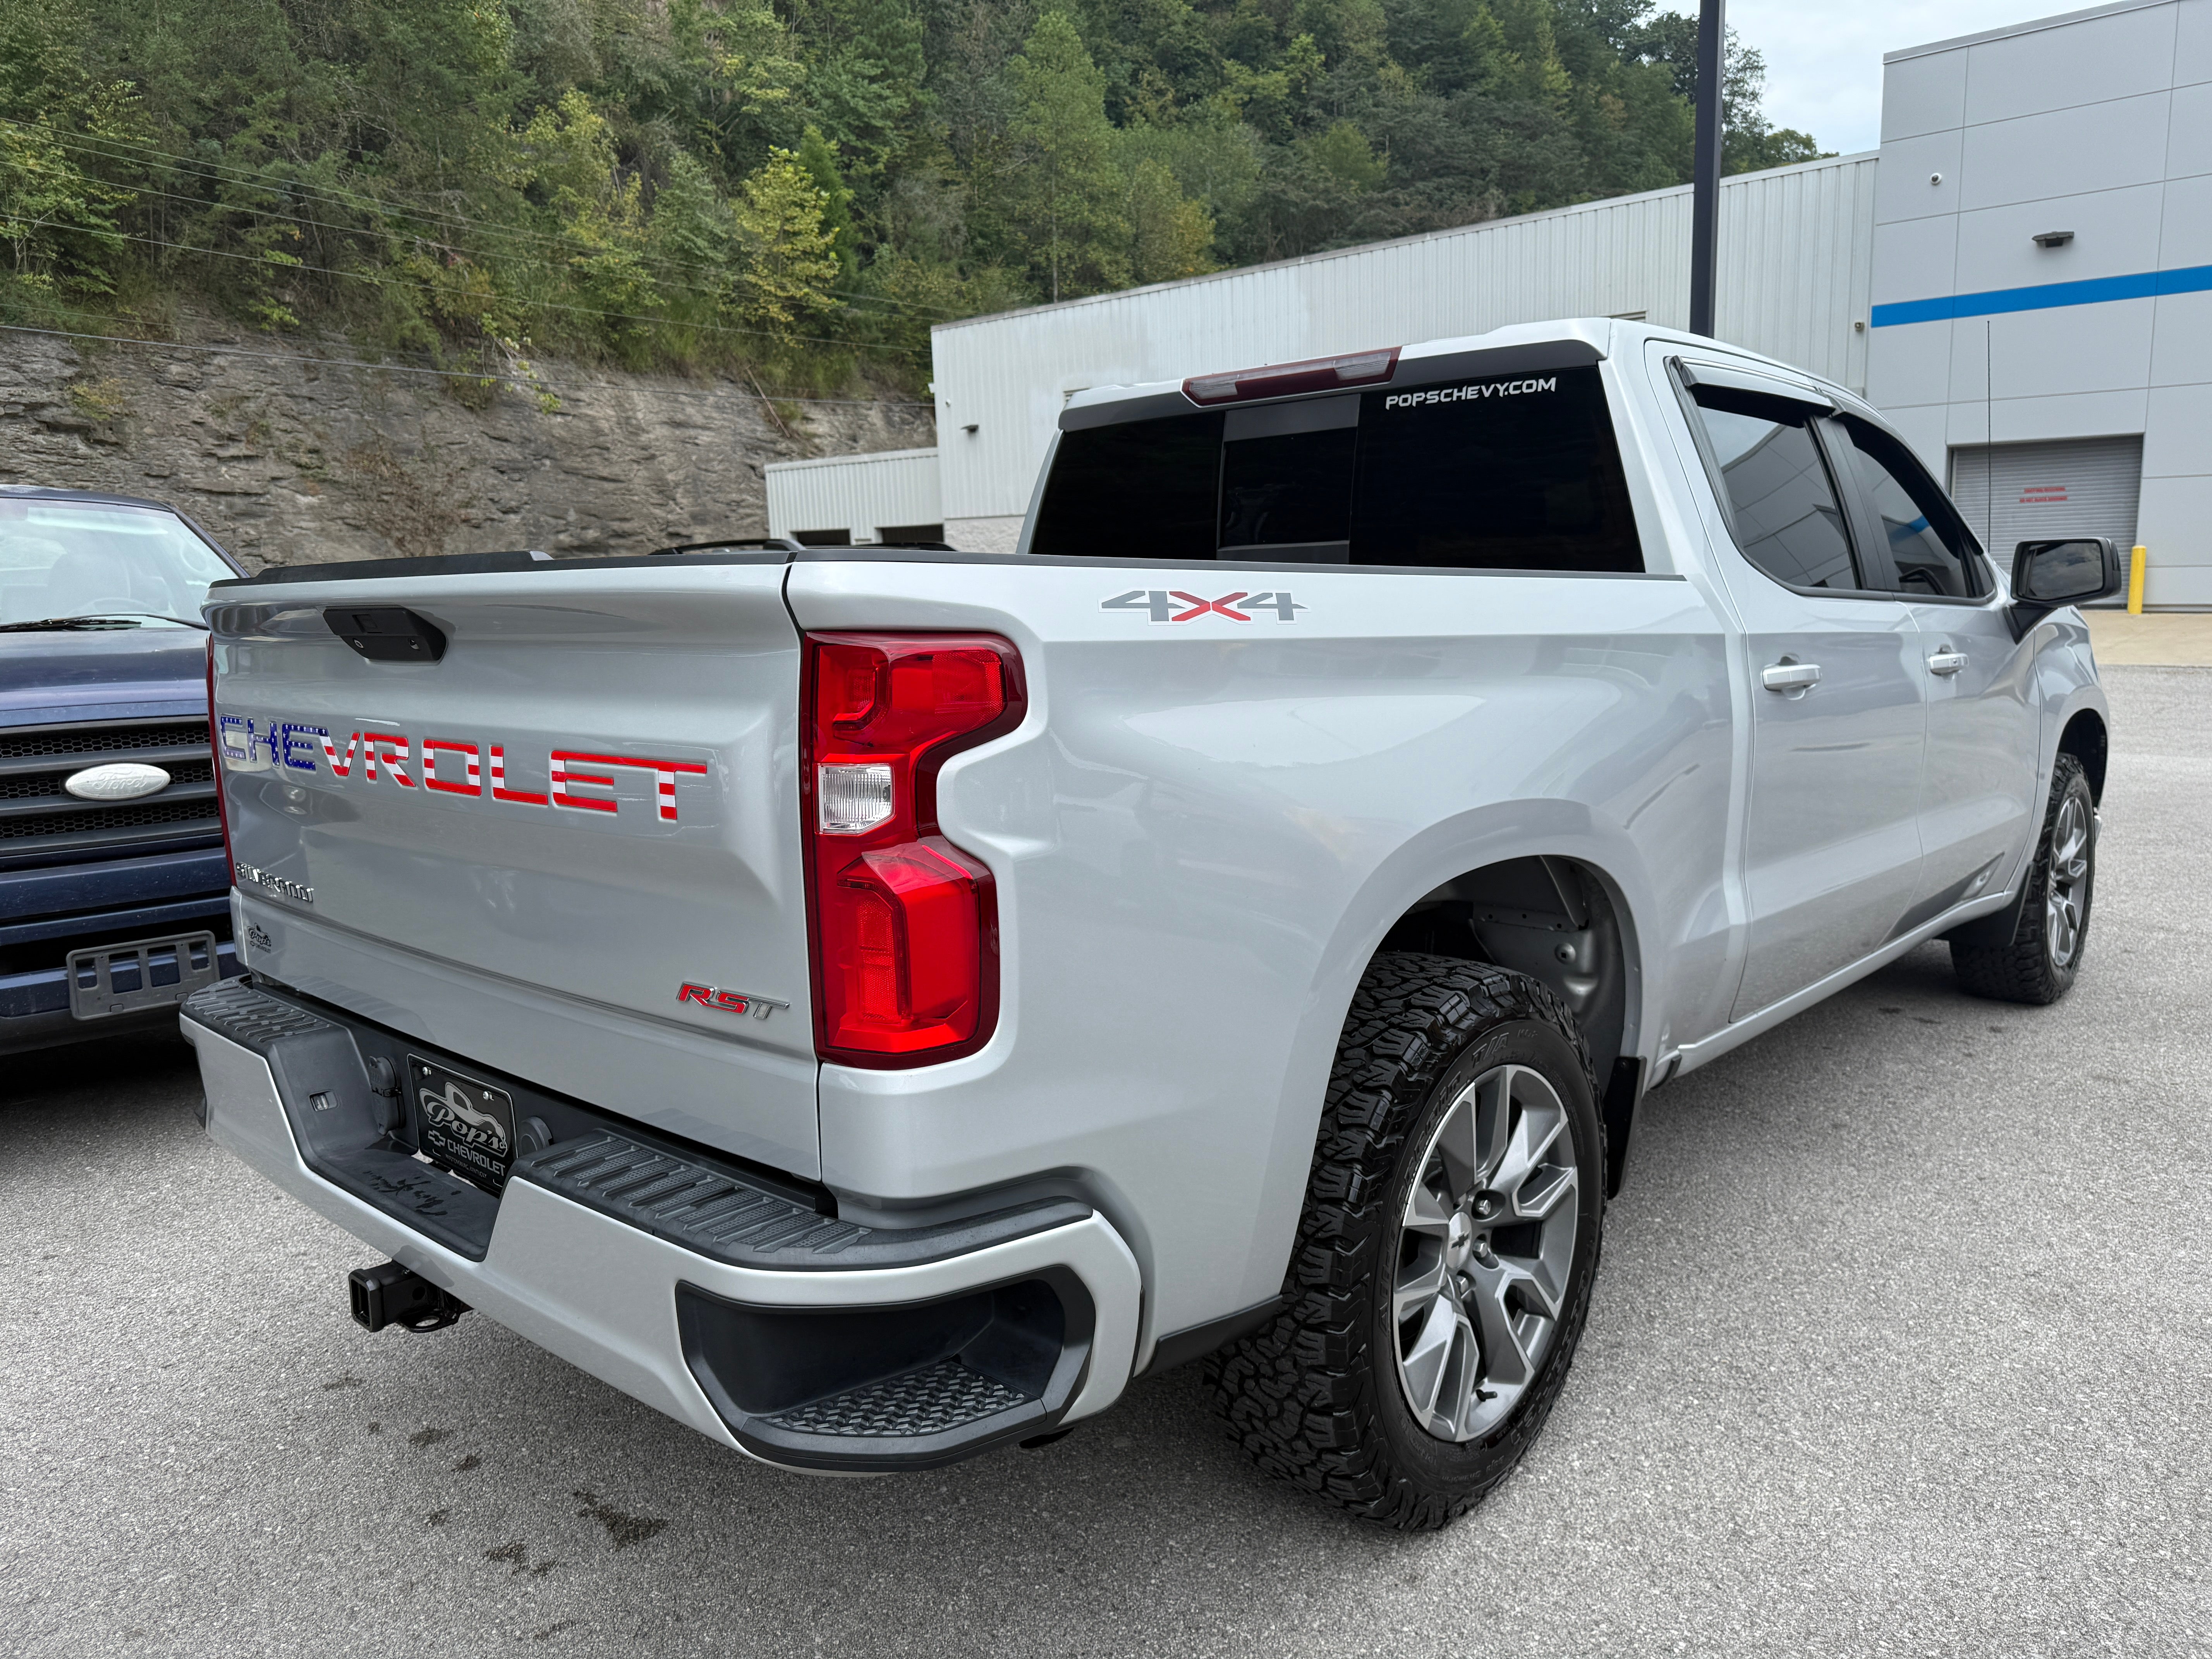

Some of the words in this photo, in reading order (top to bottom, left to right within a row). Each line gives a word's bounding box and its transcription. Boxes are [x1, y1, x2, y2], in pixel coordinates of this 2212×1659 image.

[1385, 376, 1556, 410] POPSCHEVY.COM
[1101, 590, 1308, 622] 4X4
[92, 771, 147, 789] Ford
[220, 715, 707, 821] CHEVROLET
[676, 981, 791, 1020] RST
[427, 1101, 503, 1150] Pop's
[447, 1139, 505, 1176] CHEVROLET
